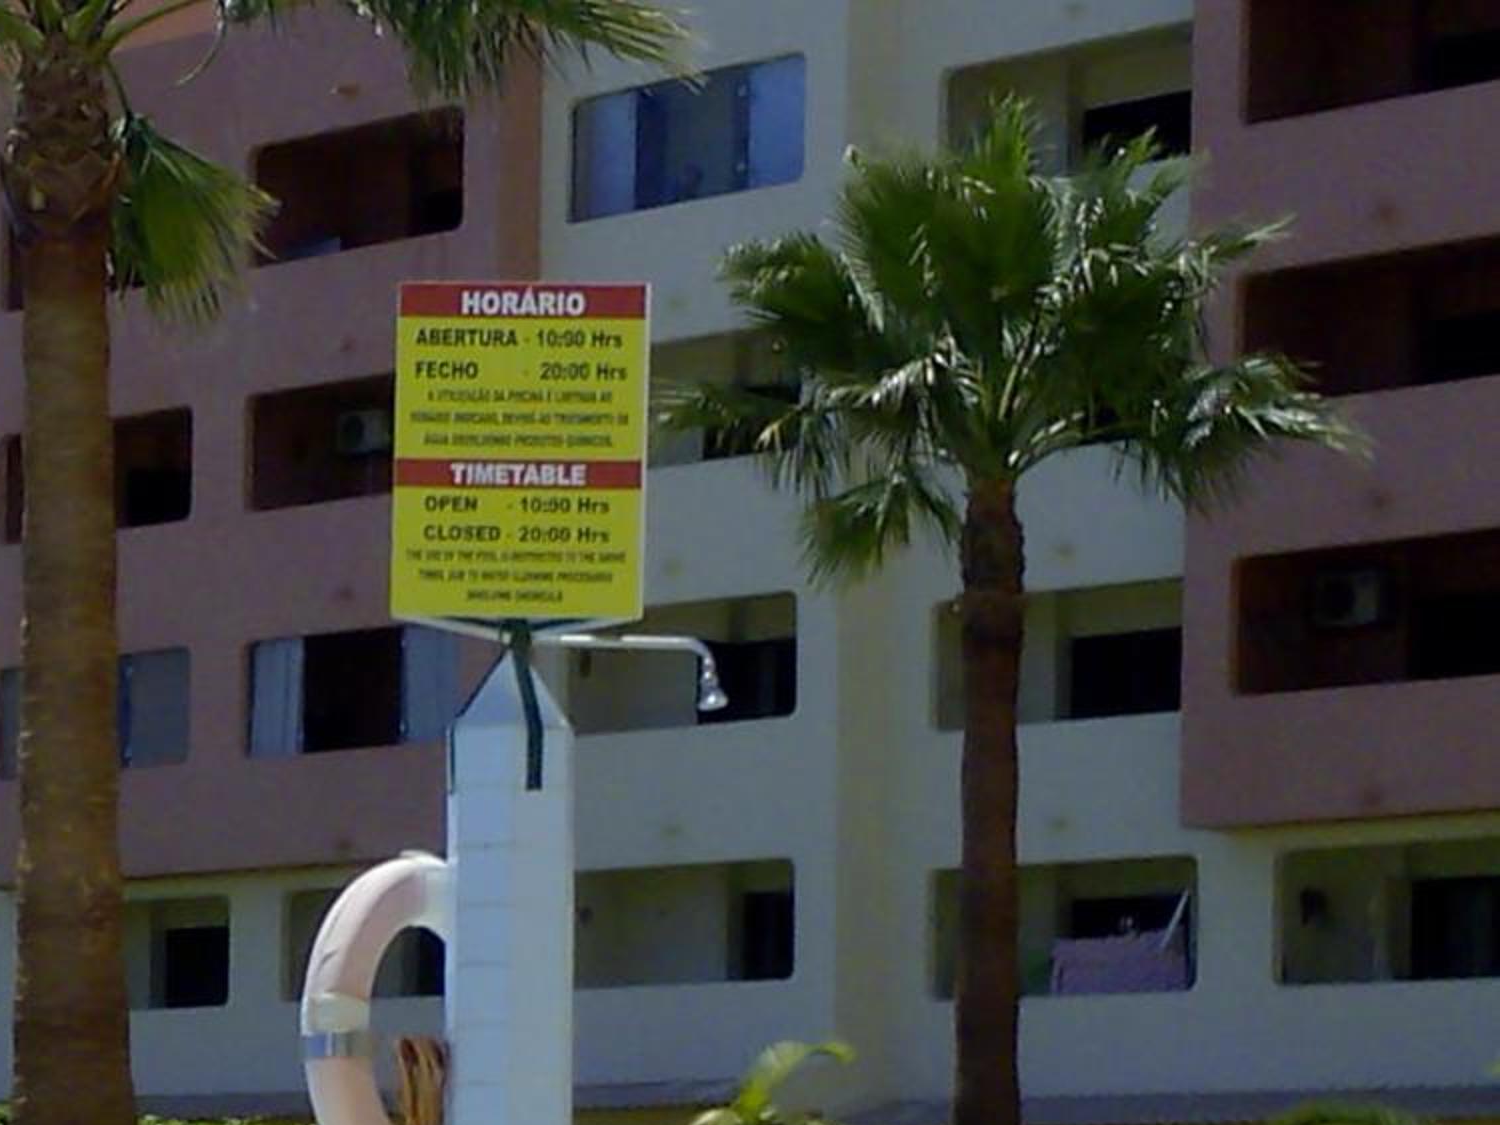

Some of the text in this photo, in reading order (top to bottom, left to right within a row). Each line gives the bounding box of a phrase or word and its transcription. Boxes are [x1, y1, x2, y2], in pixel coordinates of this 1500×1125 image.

[461, 286, 585, 316] HORÁRIO
[416, 327, 517, 347] ABERTURA
[536, 329, 585, 348] 10:00
[591, 331, 622, 348] Hrs
[415, 361, 478, 379] FECHO
[539, 362, 590, 380] 20:00
[596, 364, 628, 380] Hrs
[451, 463, 587, 486] TIMETABLE
[424, 496, 477, 512] OPEN
[519, 496, 570, 513] 10:00
[577, 498, 610, 513] Hrs
[423, 525, 500, 541] CLOSED
[518, 526, 570, 542] 20:00
[577, 527, 610, 543] Hrs
